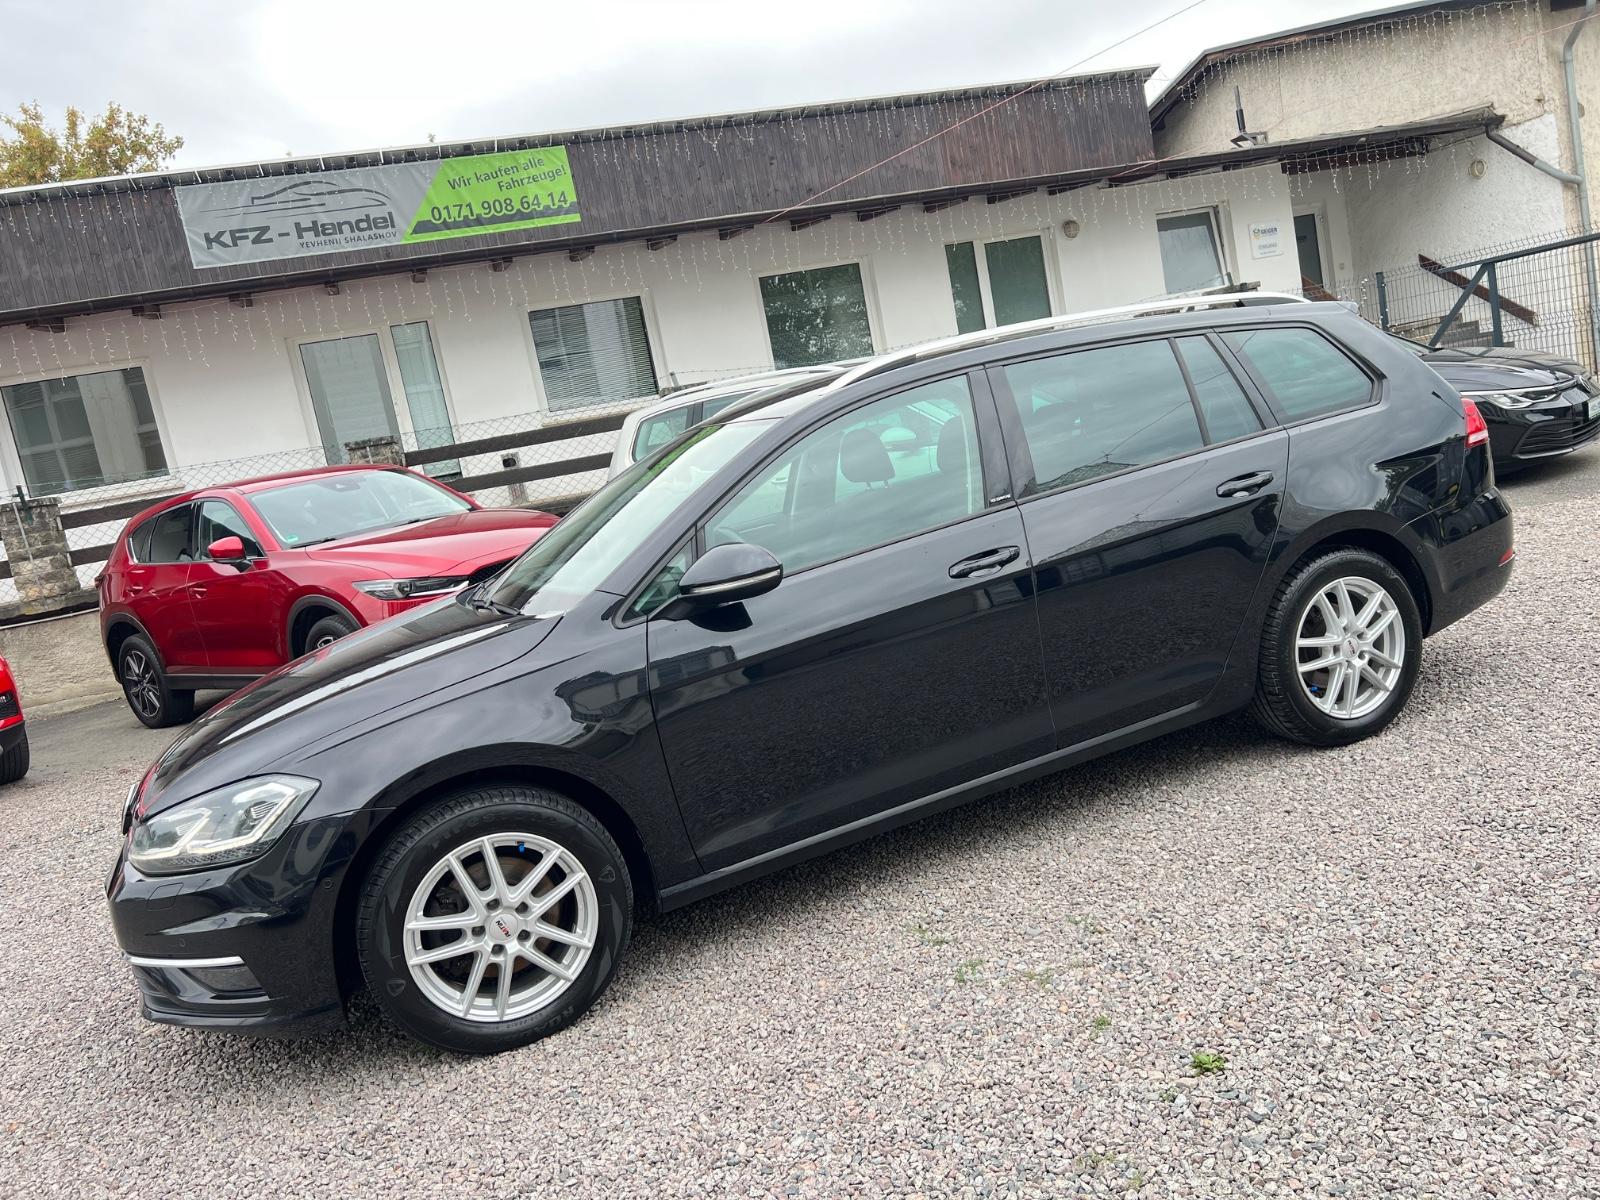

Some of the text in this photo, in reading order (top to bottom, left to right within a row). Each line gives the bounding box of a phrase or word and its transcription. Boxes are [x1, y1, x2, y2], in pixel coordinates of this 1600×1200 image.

[447, 157, 545, 191] Wir kaufen alle
[498, 164, 568, 192] Fahrzeuge!
[431, 190, 569, 222] 0171 908 64 14
[203, 225, 274, 250] KFZ
[294, 211, 396, 240] Handel
[300, 231, 397, 249] YEVHENII SHALASHOV
